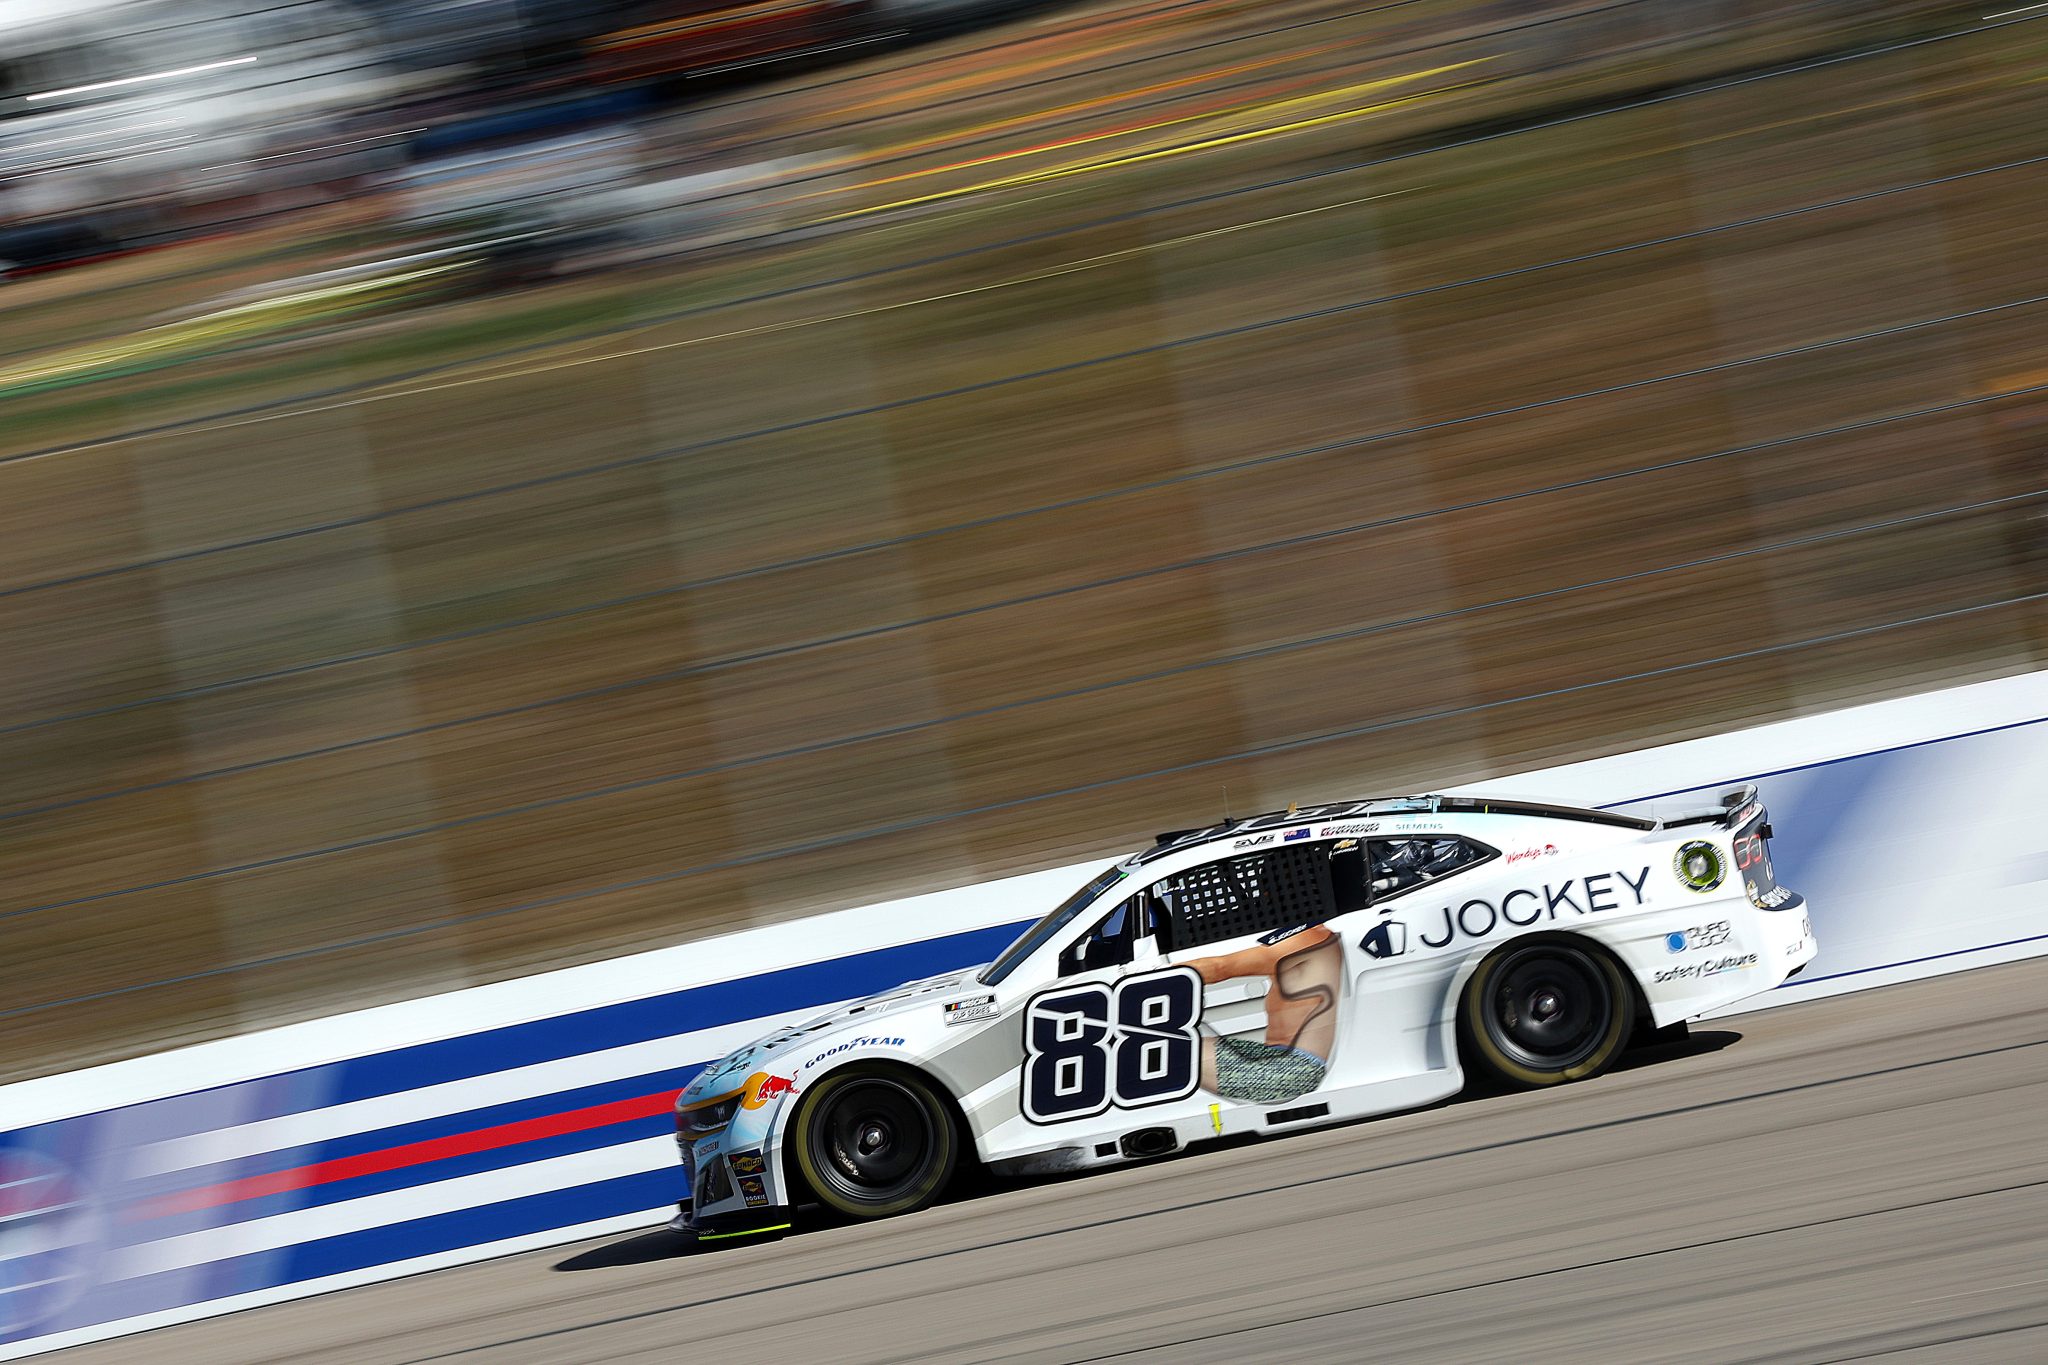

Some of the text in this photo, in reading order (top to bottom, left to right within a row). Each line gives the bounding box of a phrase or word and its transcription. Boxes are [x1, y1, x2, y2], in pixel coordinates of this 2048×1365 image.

[1395, 822, 1443, 831] SIEMENS
[1420, 865, 1651, 949] JOCKEY
[1690, 931, 1733, 951] LOCK
[1652, 951, 1759, 985] SafetyCulture
[804, 1035, 906, 1069] GOODYEAR
[1021, 965, 1203, 1126] 88
[732, 1156, 762, 1170] SUNOCO
